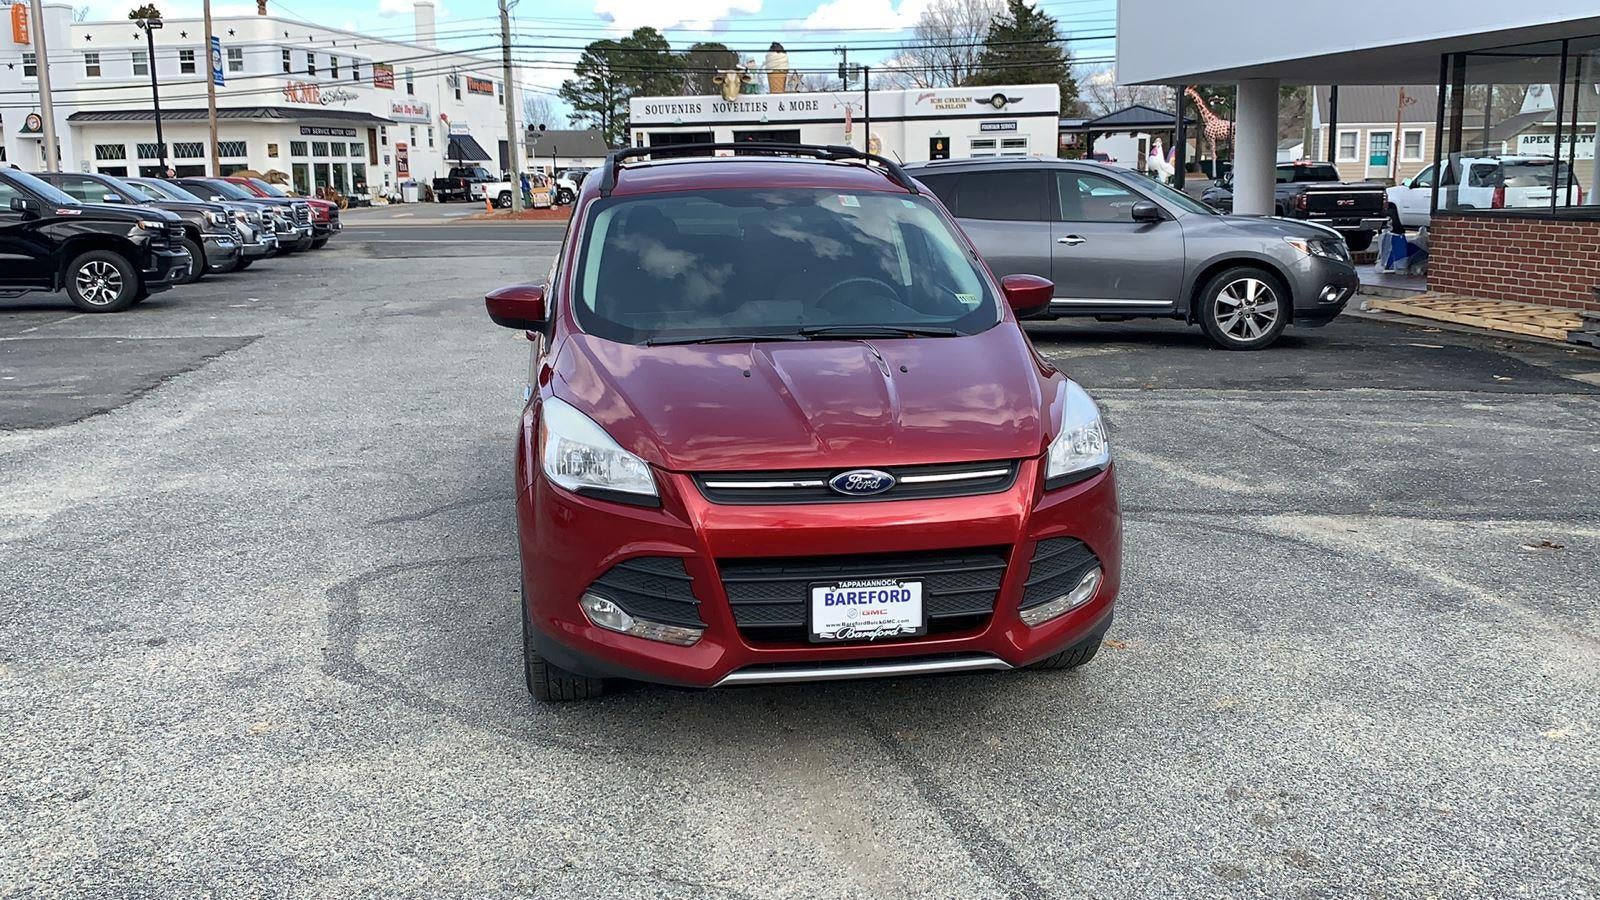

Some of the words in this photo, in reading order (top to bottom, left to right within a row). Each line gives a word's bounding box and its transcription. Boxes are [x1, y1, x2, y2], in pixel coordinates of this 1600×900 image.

[282, 81, 321, 105] ACME
[944, 96, 973, 104] CREAM
[645, 104, 702, 115] SOUVENIRS
[712, 102, 768, 113] NOVELTIES
[778, 101, 785, 111] &
[789, 100, 819, 111] MORE
[301, 127, 311, 135] CITY
[312, 127, 330, 135] SERVICE
[1000, 122, 1016, 130] SERVICE
[1522, 135, 1551, 144] APEX
[1555, 134, 1596, 144] EALTY
[845, 473, 882, 490] Ford
[838, 579, 897, 588] TAPPAHANNOCK
[824, 589, 912, 607] BAREFORD
[862, 608, 888, 616] GMC
[836, 624, 902, 641] Bareford
